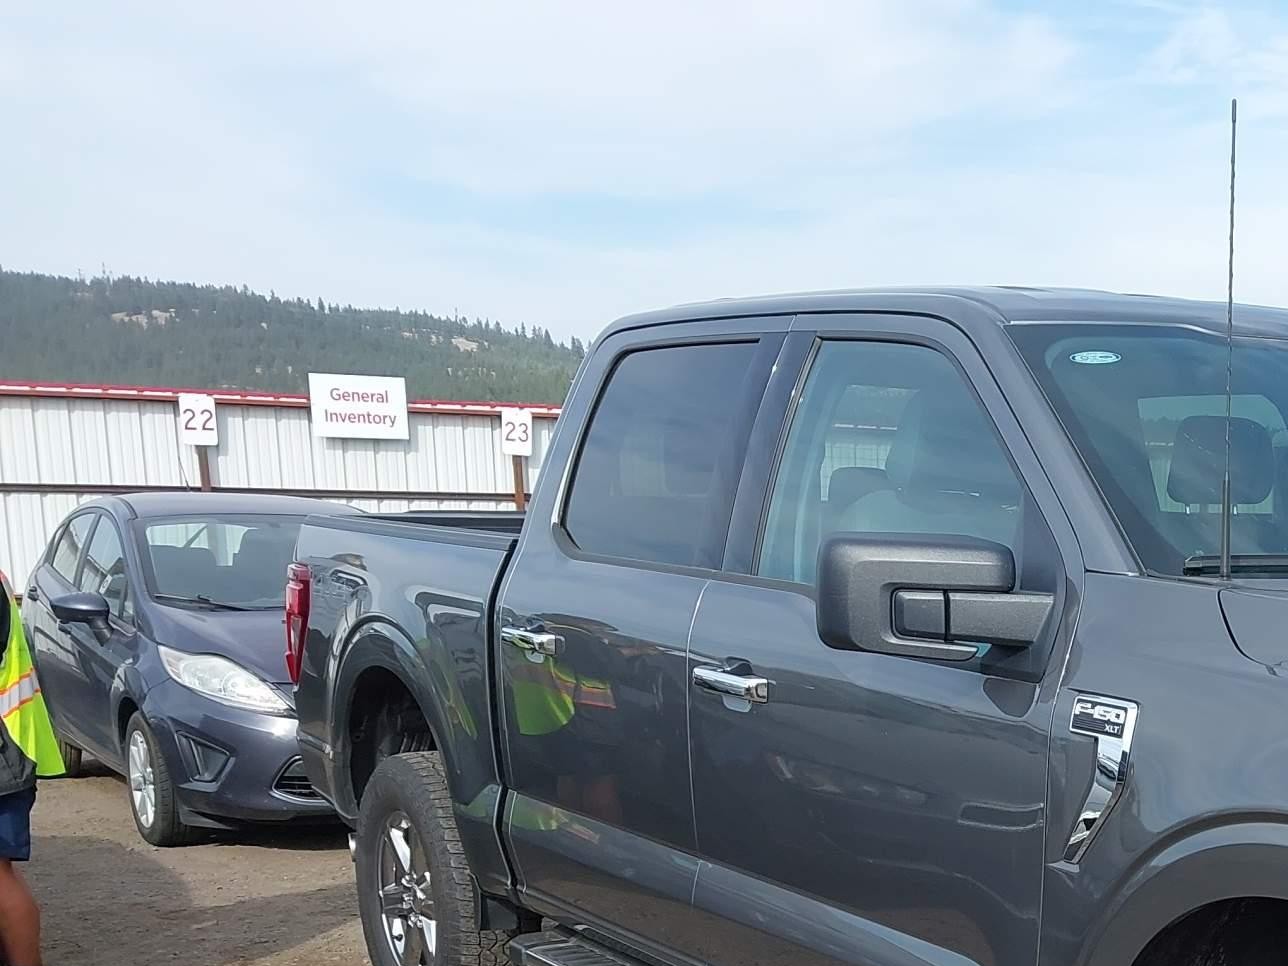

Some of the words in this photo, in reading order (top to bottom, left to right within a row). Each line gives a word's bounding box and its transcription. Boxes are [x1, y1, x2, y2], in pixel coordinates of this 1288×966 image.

[329, 387, 389, 404] General
[183, 408, 216, 432] 22
[324, 409, 397, 428] Inventory
[504, 421, 530, 443] 23
[1104, 723, 1119, 734] XLT
